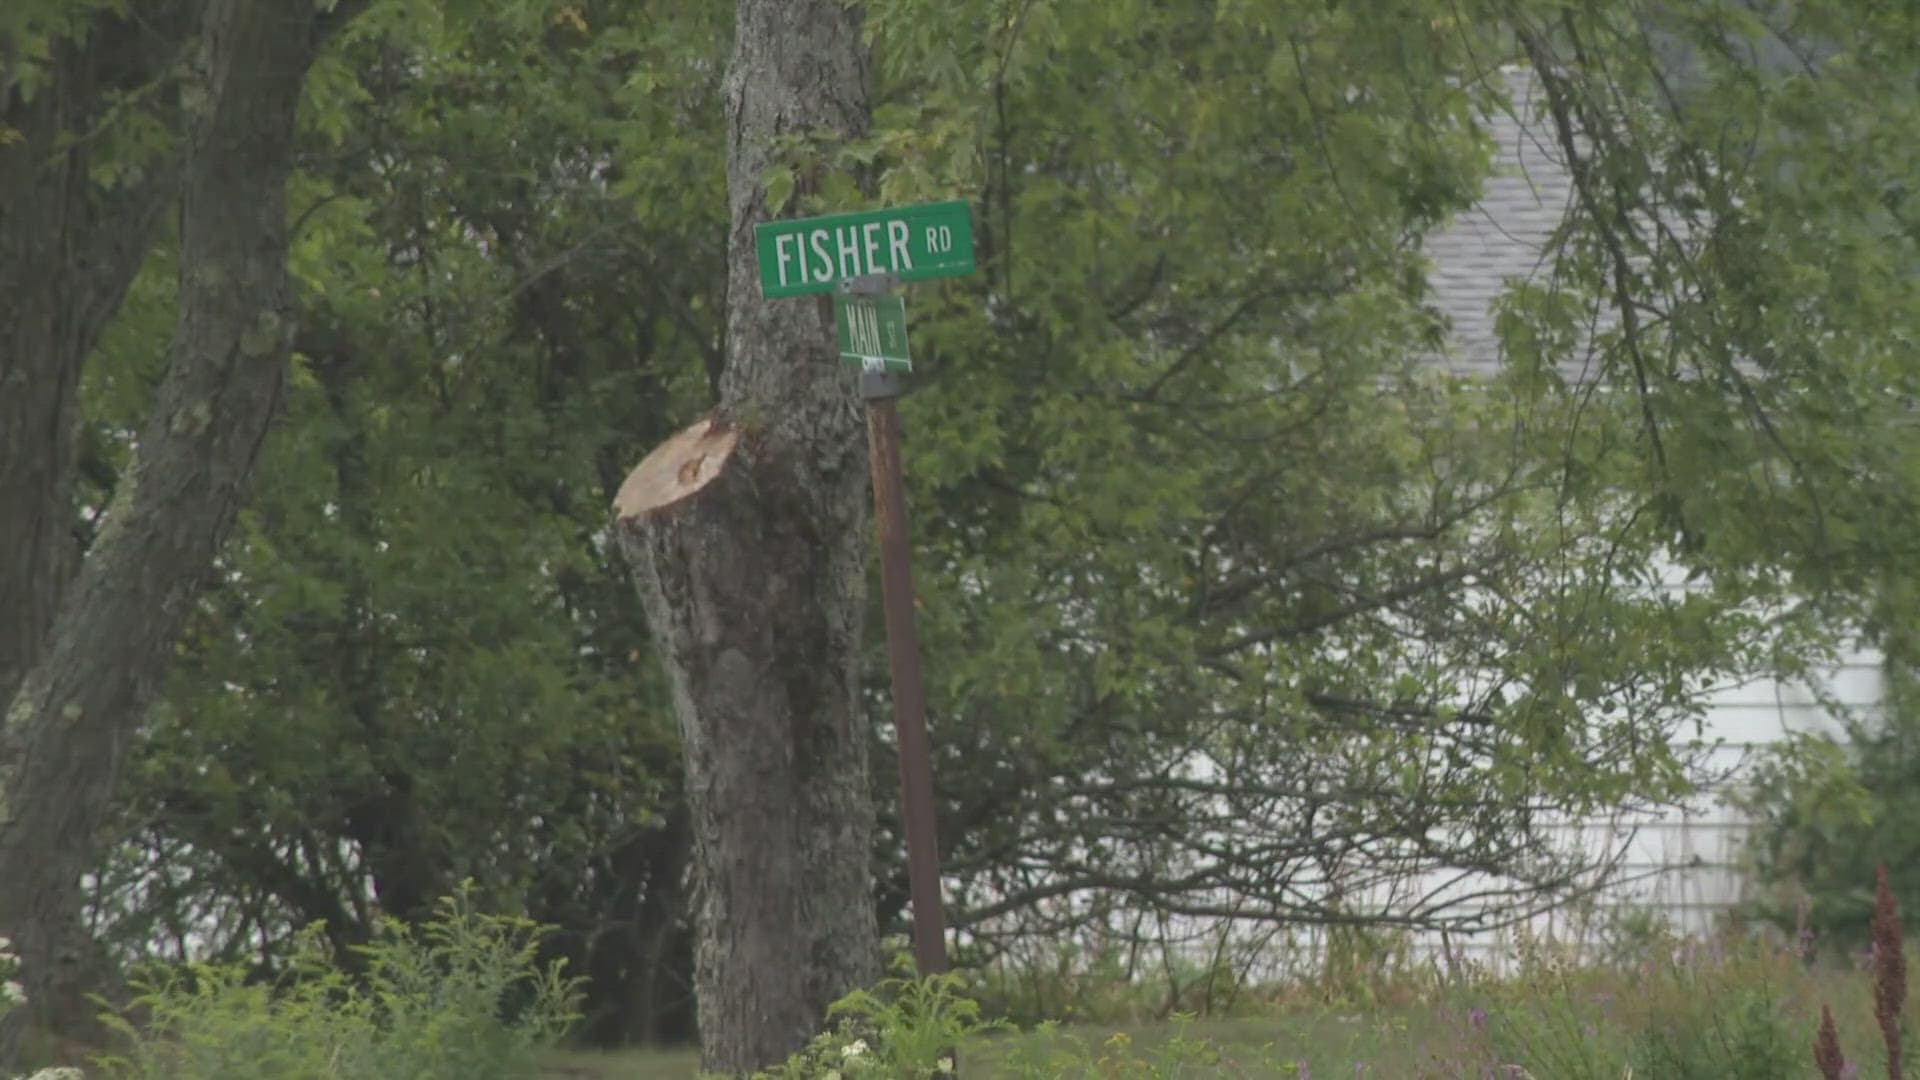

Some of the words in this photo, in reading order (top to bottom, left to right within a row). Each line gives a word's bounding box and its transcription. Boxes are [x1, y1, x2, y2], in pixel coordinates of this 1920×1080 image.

[775, 219, 913, 287] FISHER
[925, 225, 952, 254] RD
[846, 303, 882, 355] MAIN
